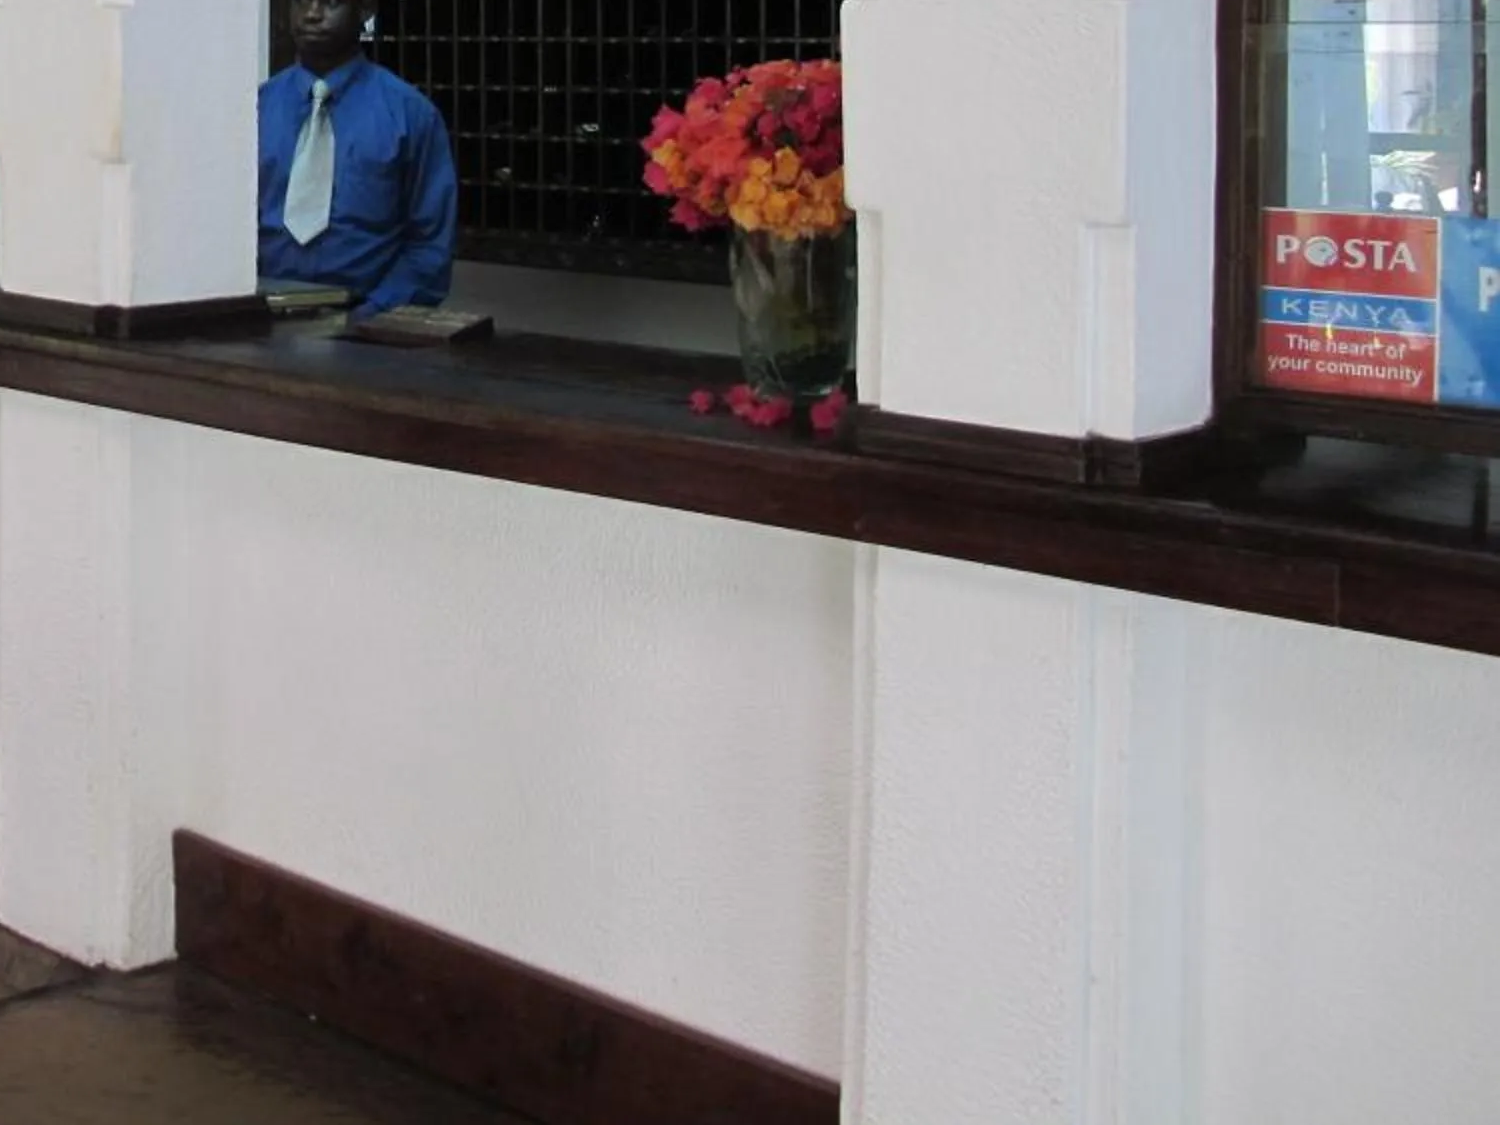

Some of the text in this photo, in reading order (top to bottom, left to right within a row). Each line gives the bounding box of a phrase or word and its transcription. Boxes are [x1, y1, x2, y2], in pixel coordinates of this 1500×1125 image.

[1275, 234, 1417, 273] POSTA
[1280, 298, 1414, 325] KENYA
[1285, 334, 1407, 360] The heart of
[1267, 355, 1425, 388] your community
